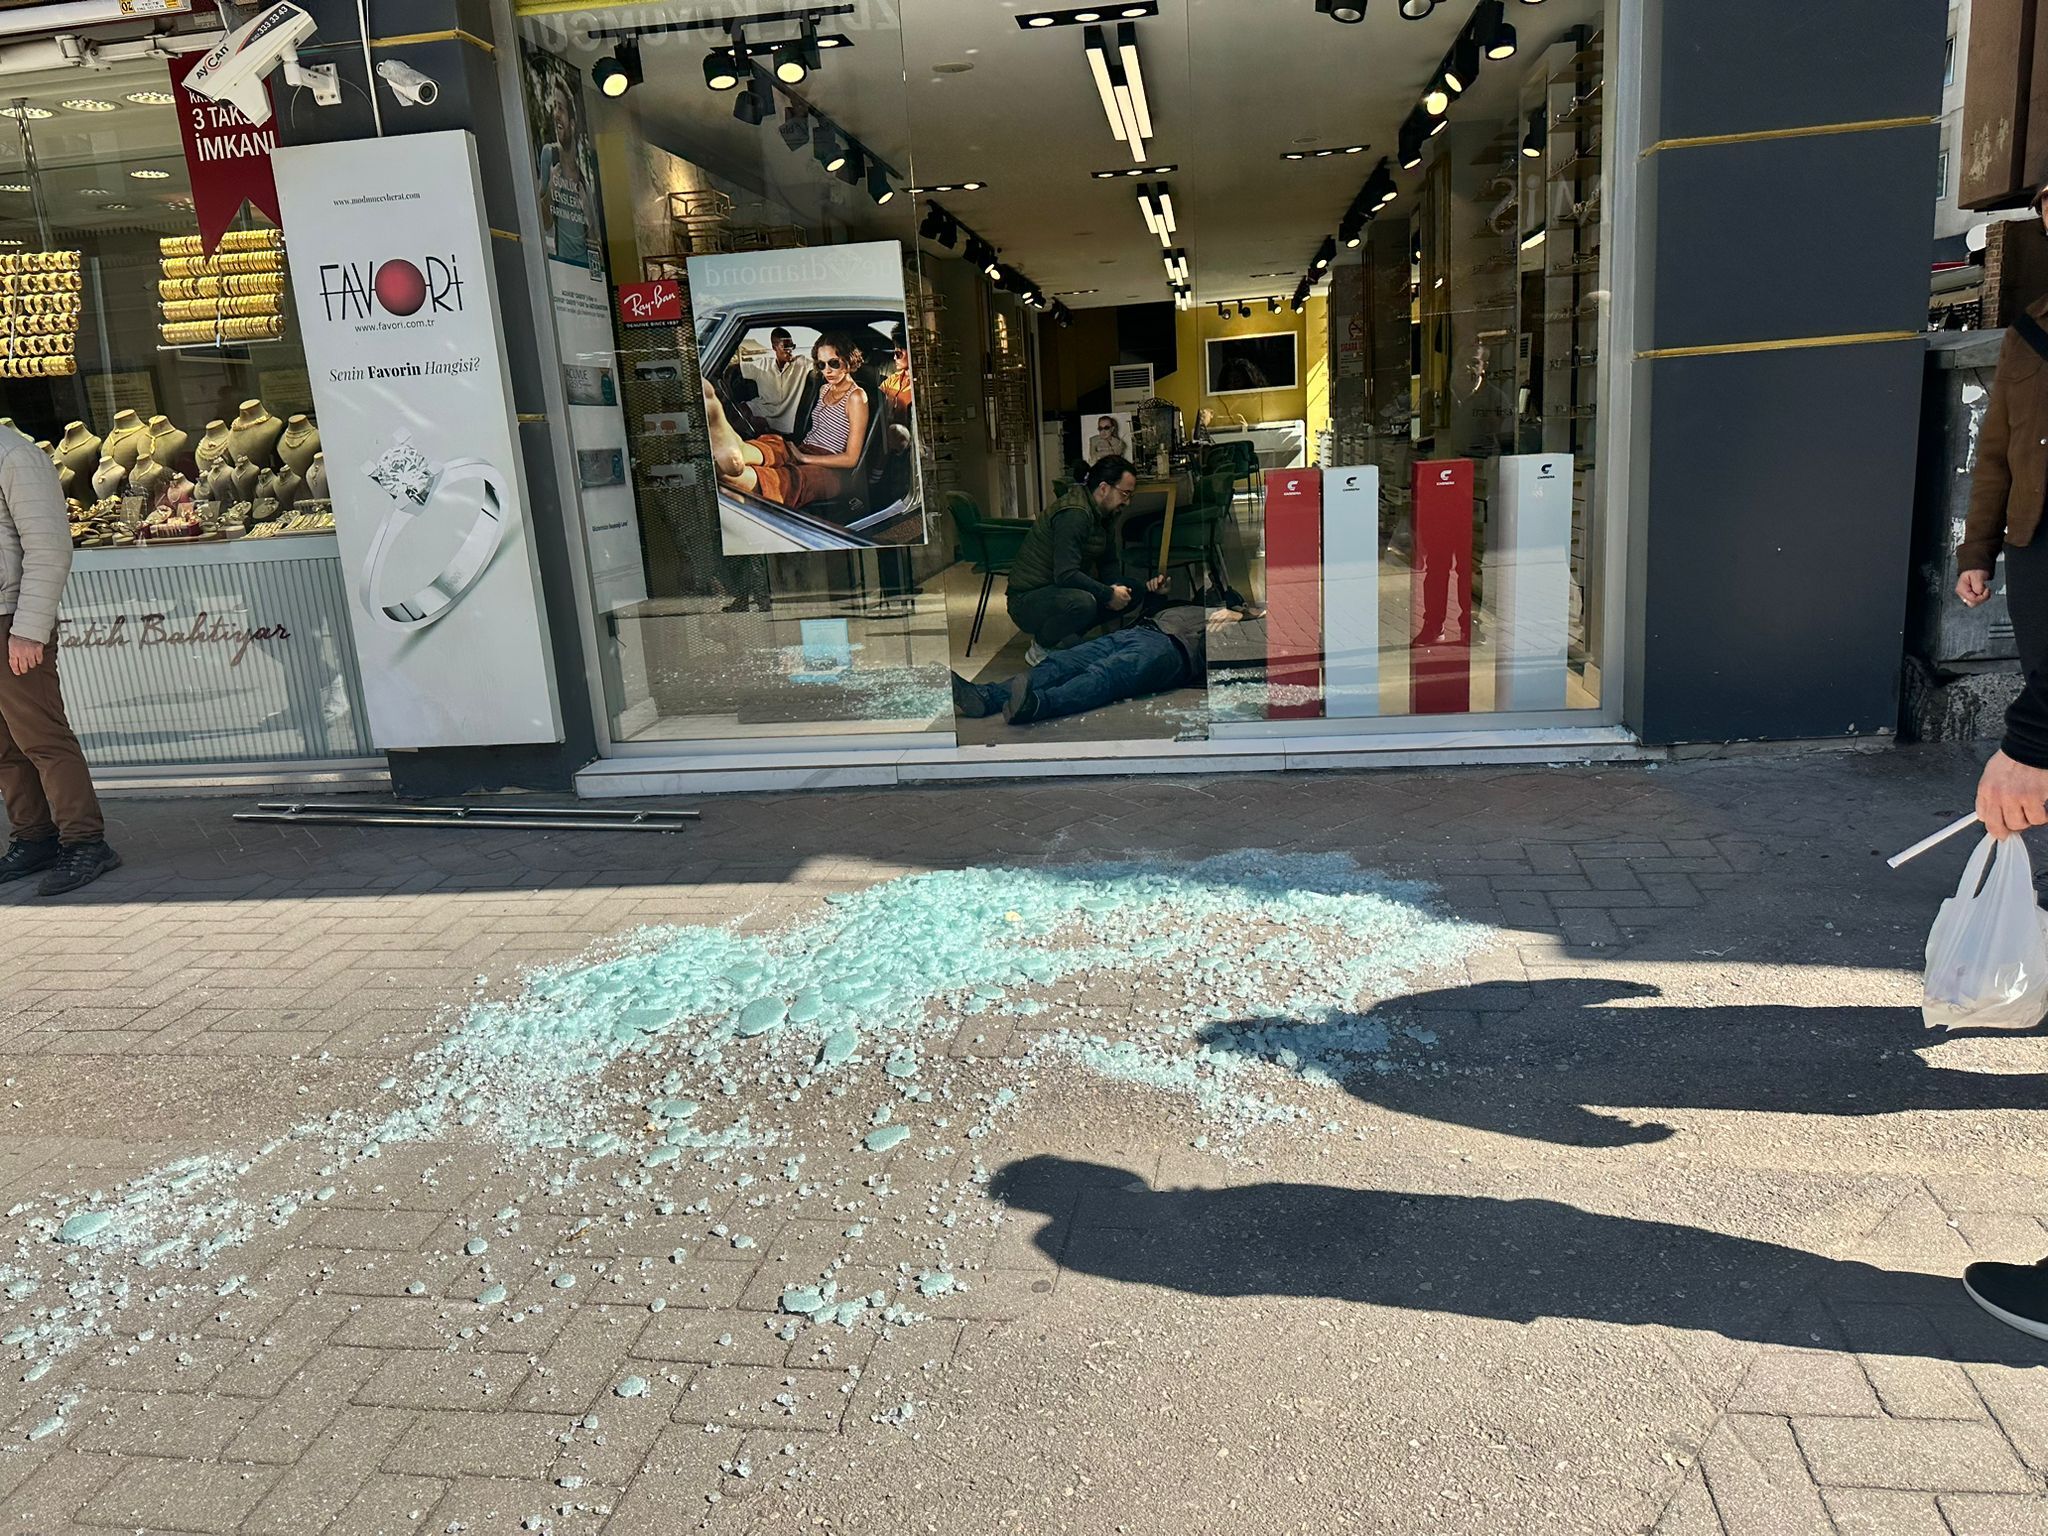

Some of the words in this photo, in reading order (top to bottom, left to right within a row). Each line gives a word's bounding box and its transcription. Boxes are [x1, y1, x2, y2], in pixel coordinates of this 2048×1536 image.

[257, 21, 271, 35] 333
[269, 13, 280, 24] 33
[278, 5, 288, 16] 43
[192, 108, 205, 130] 3
[355, 319, 435, 332] www.favori.com.tr
[329, 366, 364, 382] Senin
[368, 362, 421, 379] Favorin
[425, 357, 480, 376] Hangisi?
[139, 612, 291, 667] Bahtiyar
